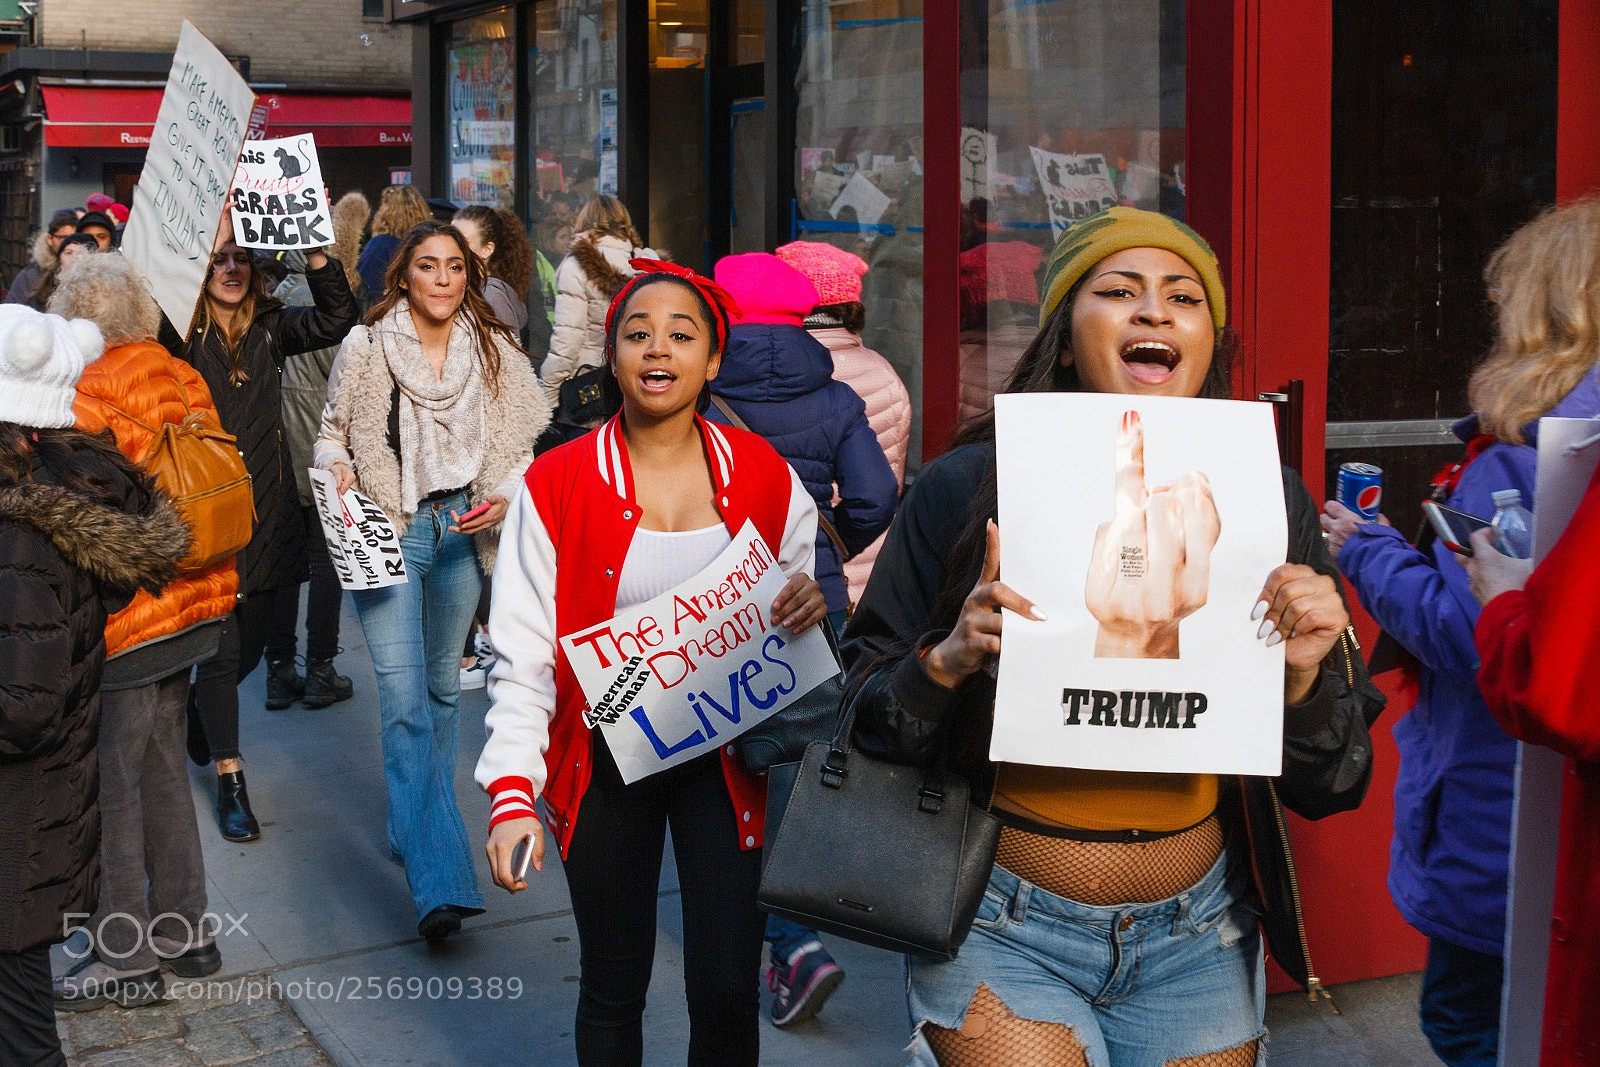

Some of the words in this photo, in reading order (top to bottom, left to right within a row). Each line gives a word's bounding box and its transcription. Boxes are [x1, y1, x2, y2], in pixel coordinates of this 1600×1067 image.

[181, 62, 207, 103] MAKE
[187, 101, 211, 138] GREAT
[168, 123, 192, 160] GIVE
[192, 153, 206, 178] IT
[173, 158, 183, 182] TO
[188, 179, 206, 216] THE
[233, 187, 318, 216] GRABS
[153, 180, 205, 260] INDIANS
[240, 213, 330, 246] BACK
[356, 519, 379, 548] OUR
[571, 616, 664, 669] The
[673, 537, 773, 635] American
[646, 602, 767, 690] Dream
[585, 655, 643, 727] American
[600, 670, 651, 726] Woman
[629, 634, 796, 760] Lives
[1062, 688, 1208, 729] TRUMP
